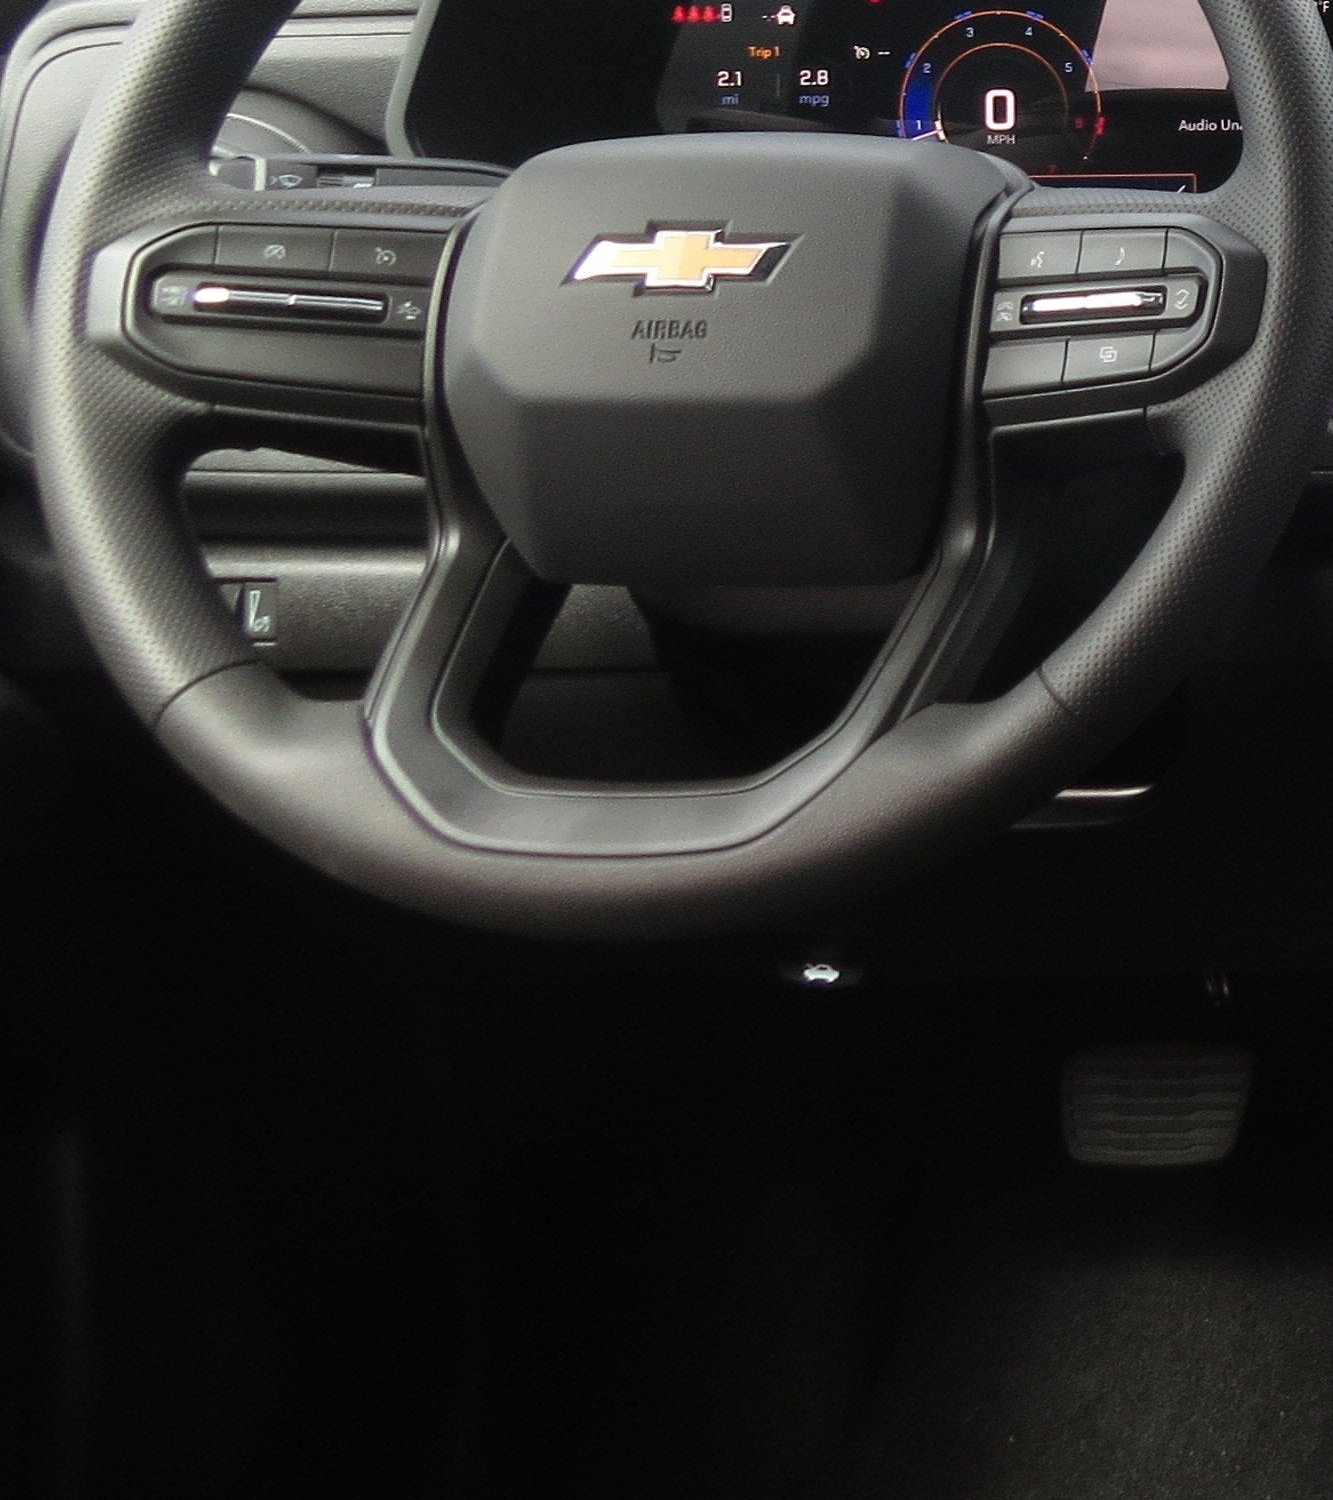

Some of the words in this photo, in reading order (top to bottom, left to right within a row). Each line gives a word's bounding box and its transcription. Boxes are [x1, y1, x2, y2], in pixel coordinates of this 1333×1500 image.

[748, 45, 773, 60] Trip
[717, 70, 742, 87] 2.1
[799, 69, 829, 86] 2.8
[721, 93, 739, 105] mi
[799, 94, 830, 107] mpg
[984, 88, 1016, 132] 0
[1178, 118, 1218, 132] Audio
[1220, 118, 1243, 132] Un
[986, 134, 1016, 145] MPH
[630, 319, 708, 340] AIRBAG
